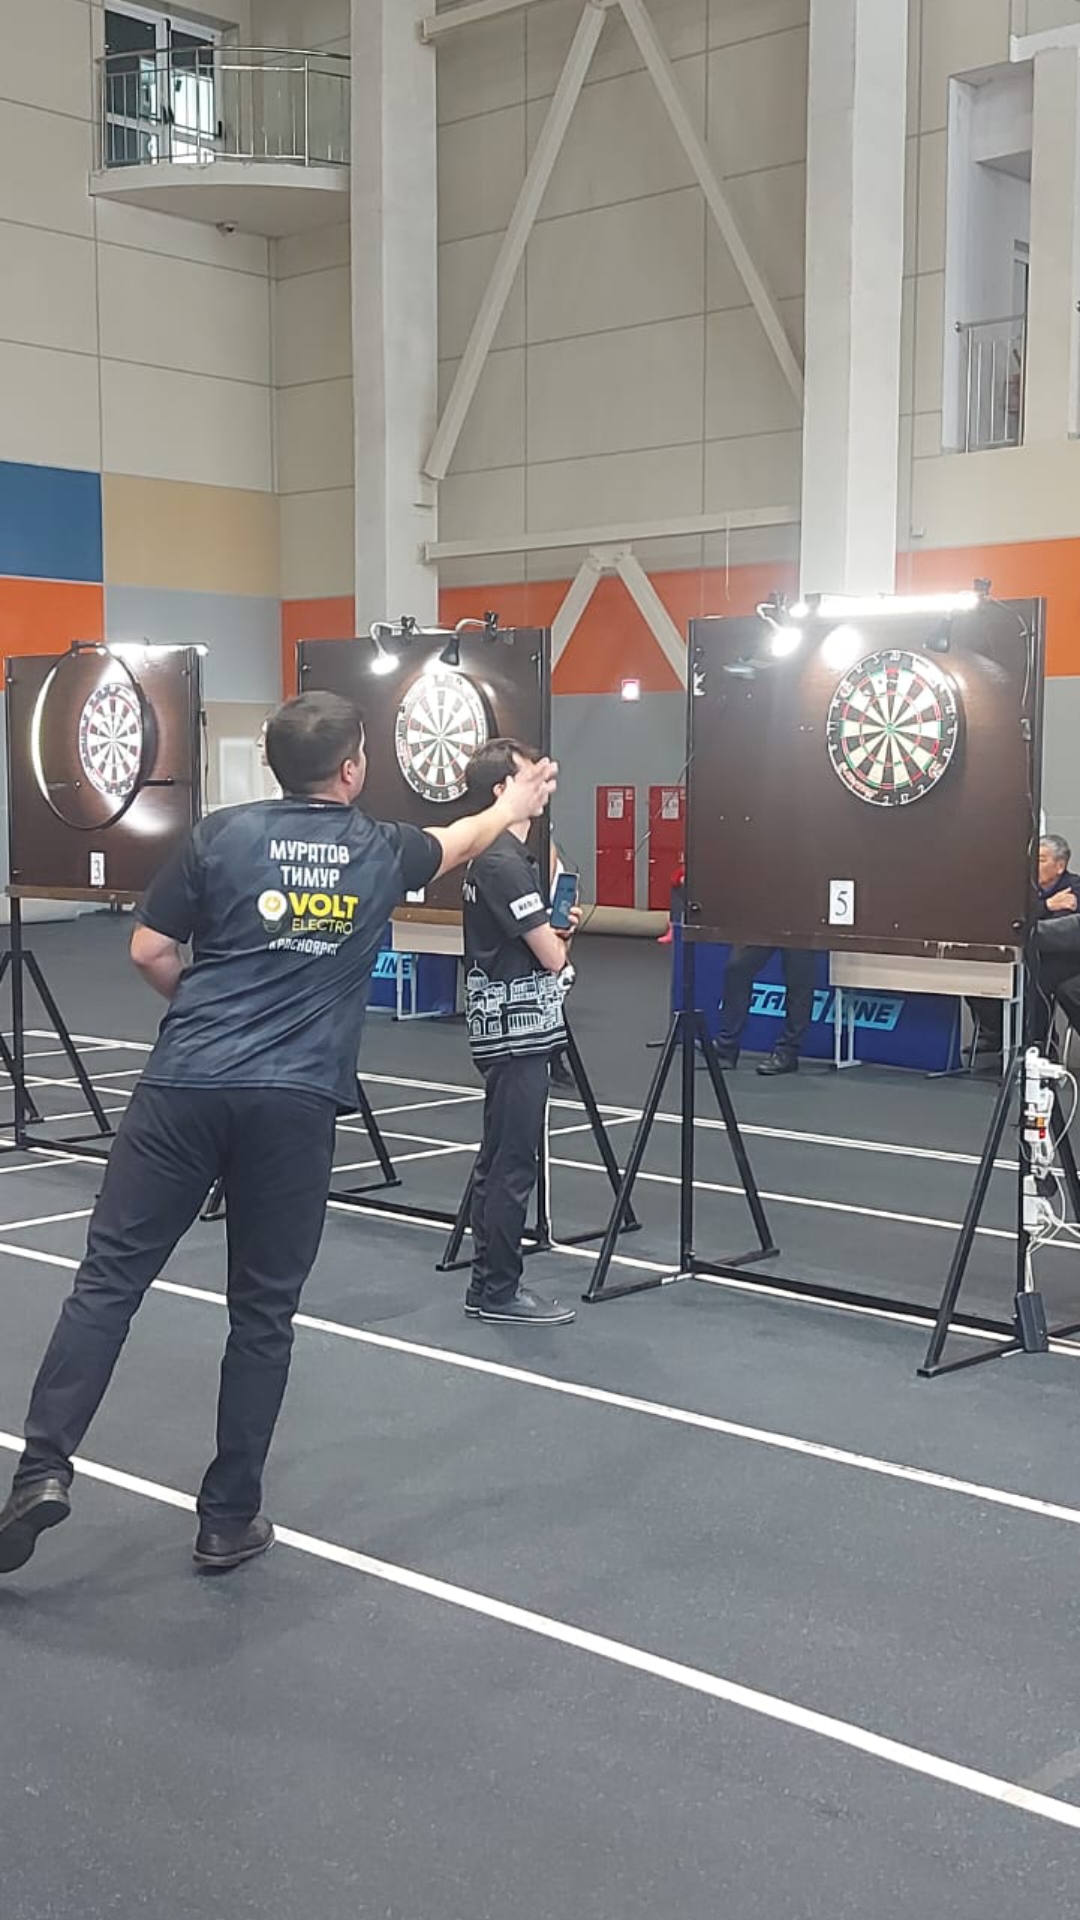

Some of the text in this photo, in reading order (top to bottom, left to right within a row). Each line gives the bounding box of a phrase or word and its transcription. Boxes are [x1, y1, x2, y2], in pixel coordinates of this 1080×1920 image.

[269, 840, 350, 864] МУРАТОВ
[94, 859, 101, 880] 3
[280, 865, 340, 888] ТИМУР
[288, 892, 358, 918] VOLT
[835, 890, 848, 916] 5
[292, 918, 353, 935] ELECTRO
